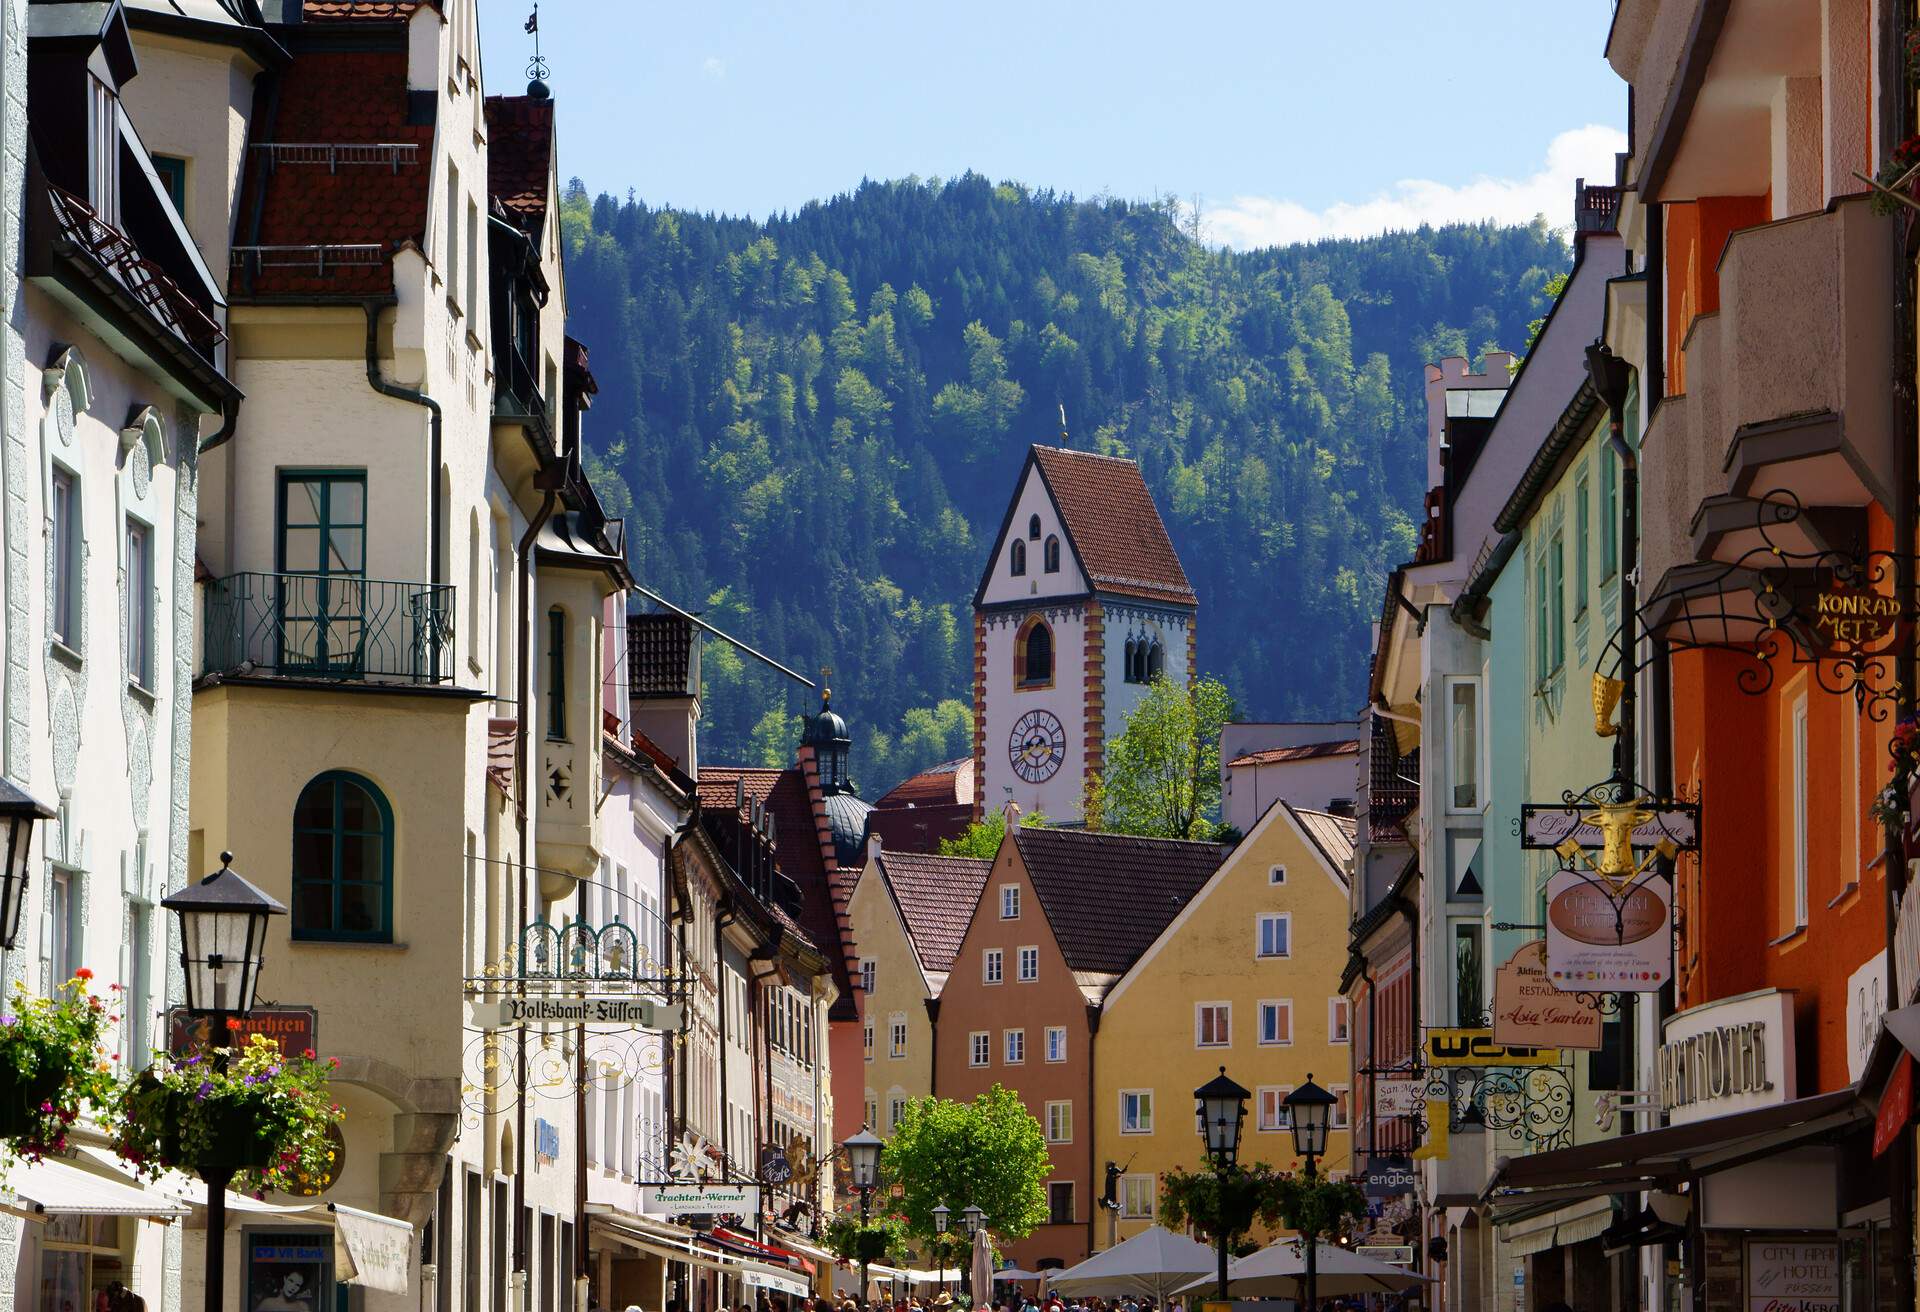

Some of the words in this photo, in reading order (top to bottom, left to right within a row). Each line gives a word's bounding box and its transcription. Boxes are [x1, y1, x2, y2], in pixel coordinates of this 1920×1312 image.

[1818, 593, 1901, 616] KONRAD
[1816, 615, 1881, 640] METZ
[1631, 826, 1684, 841] assage
[234, 1016, 305, 1034] rachten
[655, 1193, 746, 1202] Trachten-Werner
[279, 1248, 294, 1259] VR
[297, 1248, 324, 1259] Bank
[1763, 1247, 1796, 1261] CITY
[1783, 1265, 1832, 1280] HOTEL
